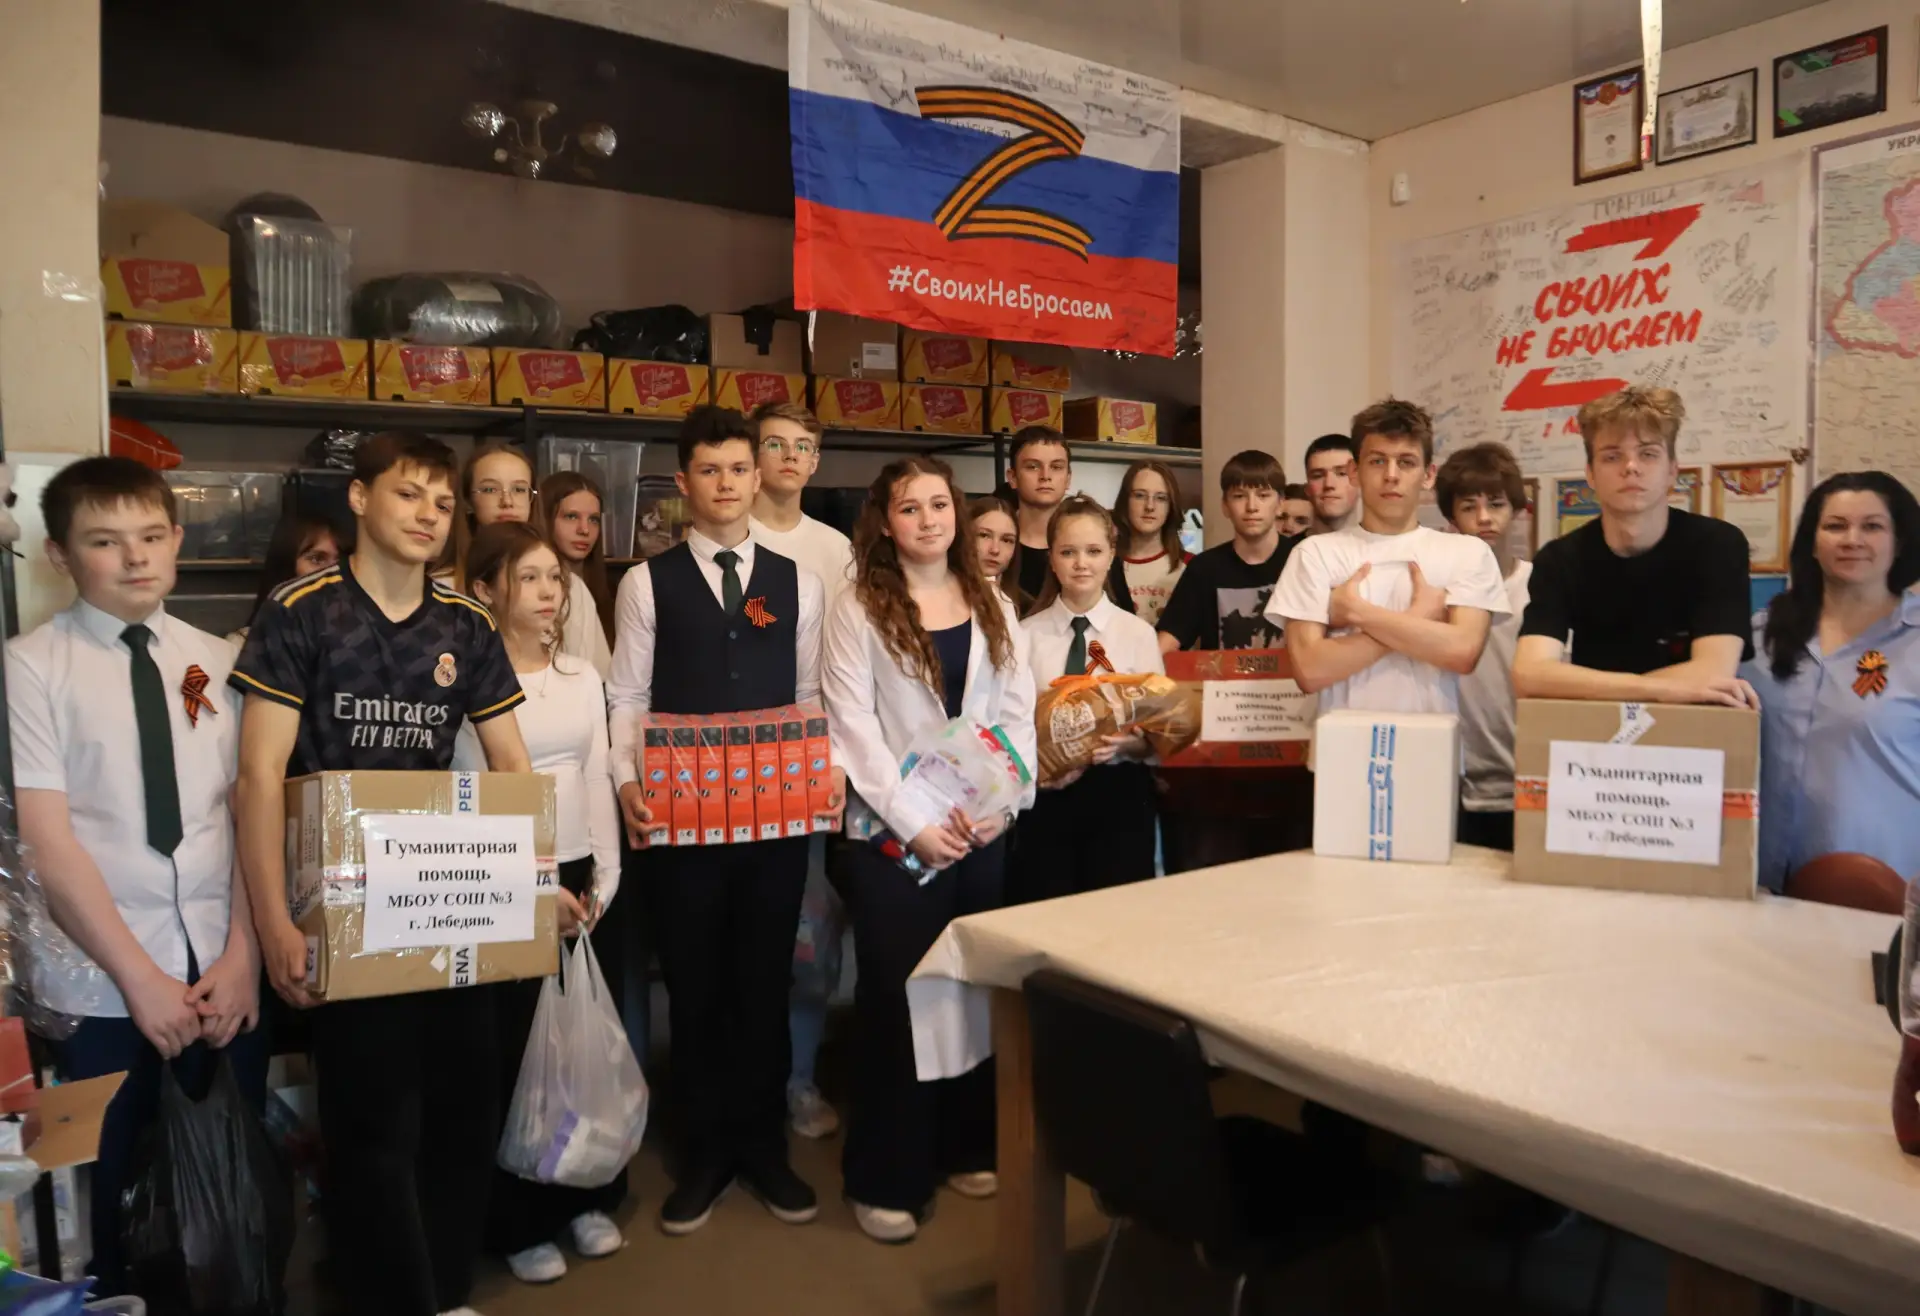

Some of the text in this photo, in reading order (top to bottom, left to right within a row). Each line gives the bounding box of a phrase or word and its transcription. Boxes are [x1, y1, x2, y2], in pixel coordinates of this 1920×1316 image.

[888, 265, 1112, 320] #СвоихНеБросаем
[1534, 262, 1671, 323] СВОИХ
[1496, 330, 1535, 368] НЕ
[1547, 309, 1703, 360] БРОСАЕМ
[334, 692, 449, 726] Emirates
[351, 725, 434, 749] FLY BETTER
[1566, 762, 1703, 786] Гуманитарная
[1595, 792, 1670, 809] помощь
[1568, 809, 1695, 831] МБОУ СОШ №3
[385, 838, 517, 859] Гуманитарная
[1607, 831, 1675, 848] Лебедянь
[418, 868, 491, 884] помощь
[387, 891, 513, 909] МБОУ СОШ №3
[409, 914, 495, 930] г. Лебедянь
